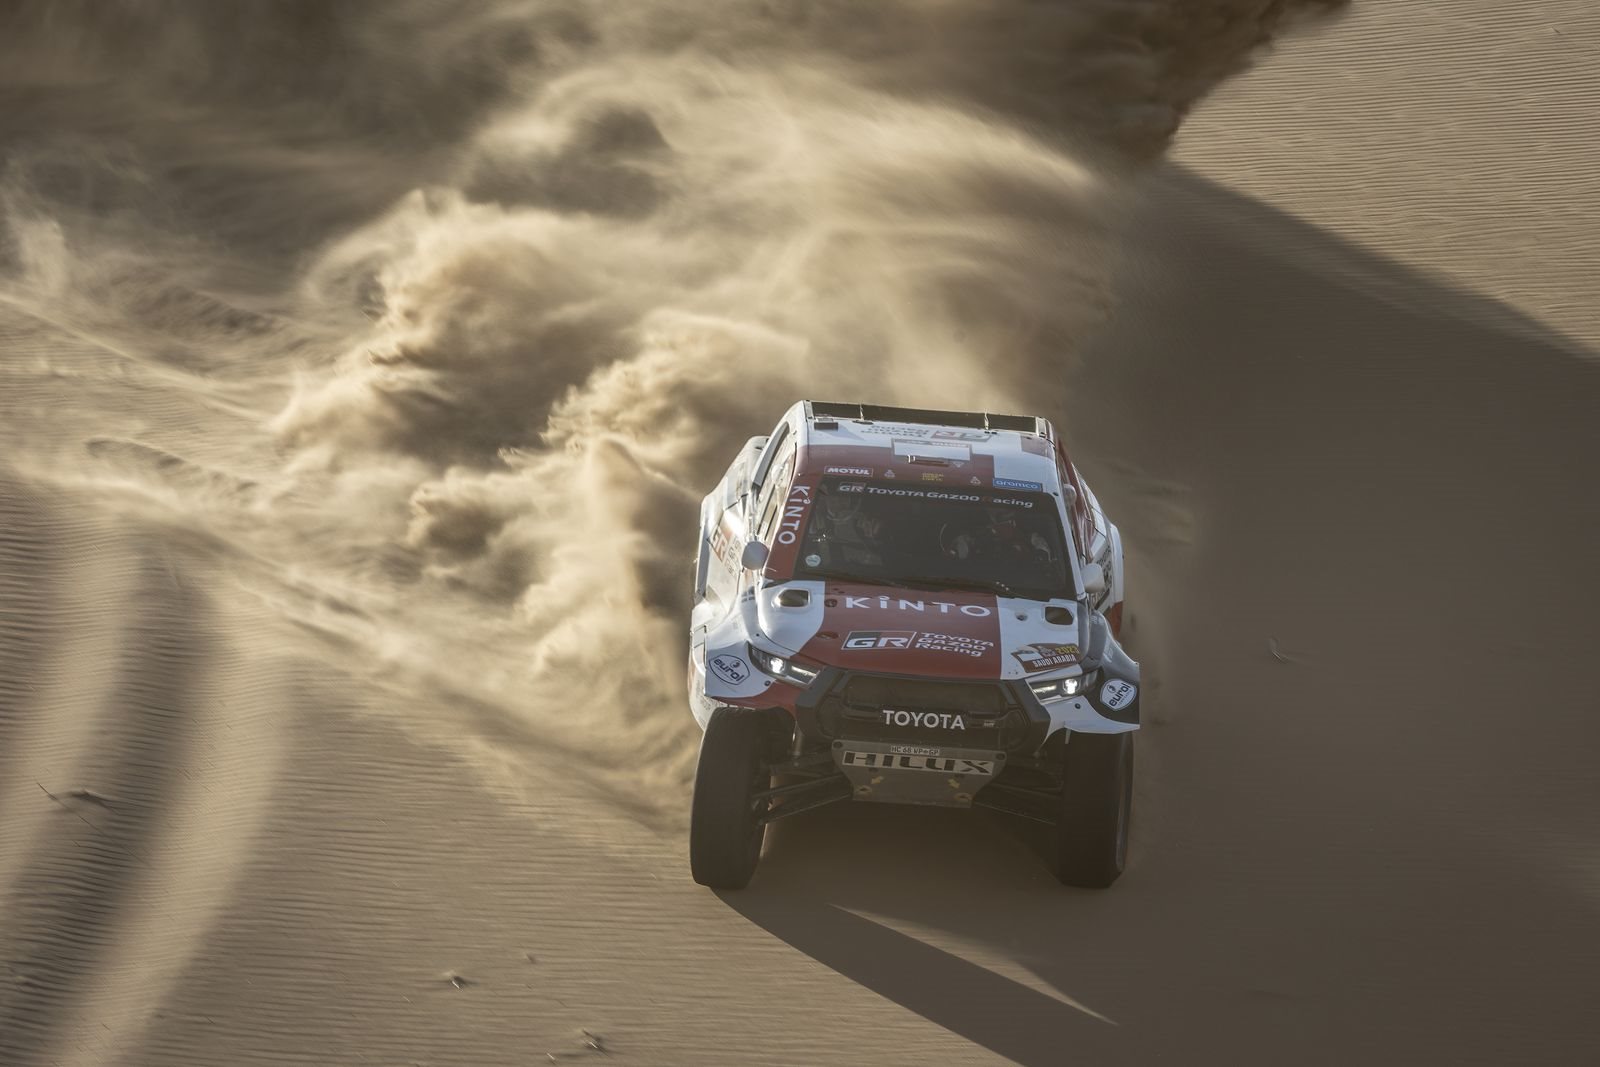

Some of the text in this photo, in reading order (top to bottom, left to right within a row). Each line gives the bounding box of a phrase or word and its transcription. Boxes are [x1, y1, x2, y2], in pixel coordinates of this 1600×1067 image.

[827, 467, 870, 475] MOTUL
[995, 480, 1039, 489] aramco
[839, 484, 865, 493] GR
[867, 486, 925, 497] TOYOTA
[926, 491, 980, 501] GAZOO
[846, 637, 909, 648] GR
[917, 638, 986, 651] GAZOO
[921, 632, 994, 647] TOYOTA
[915, 643, 983, 657] Racing
[1032, 653, 1077, 668] SAUDI ARABIA
[713, 658, 745, 682] eurol
[1108, 682, 1132, 707] eurol
[882, 709, 966, 730] TOYOTA
[844, 751, 991, 774] HILUX
